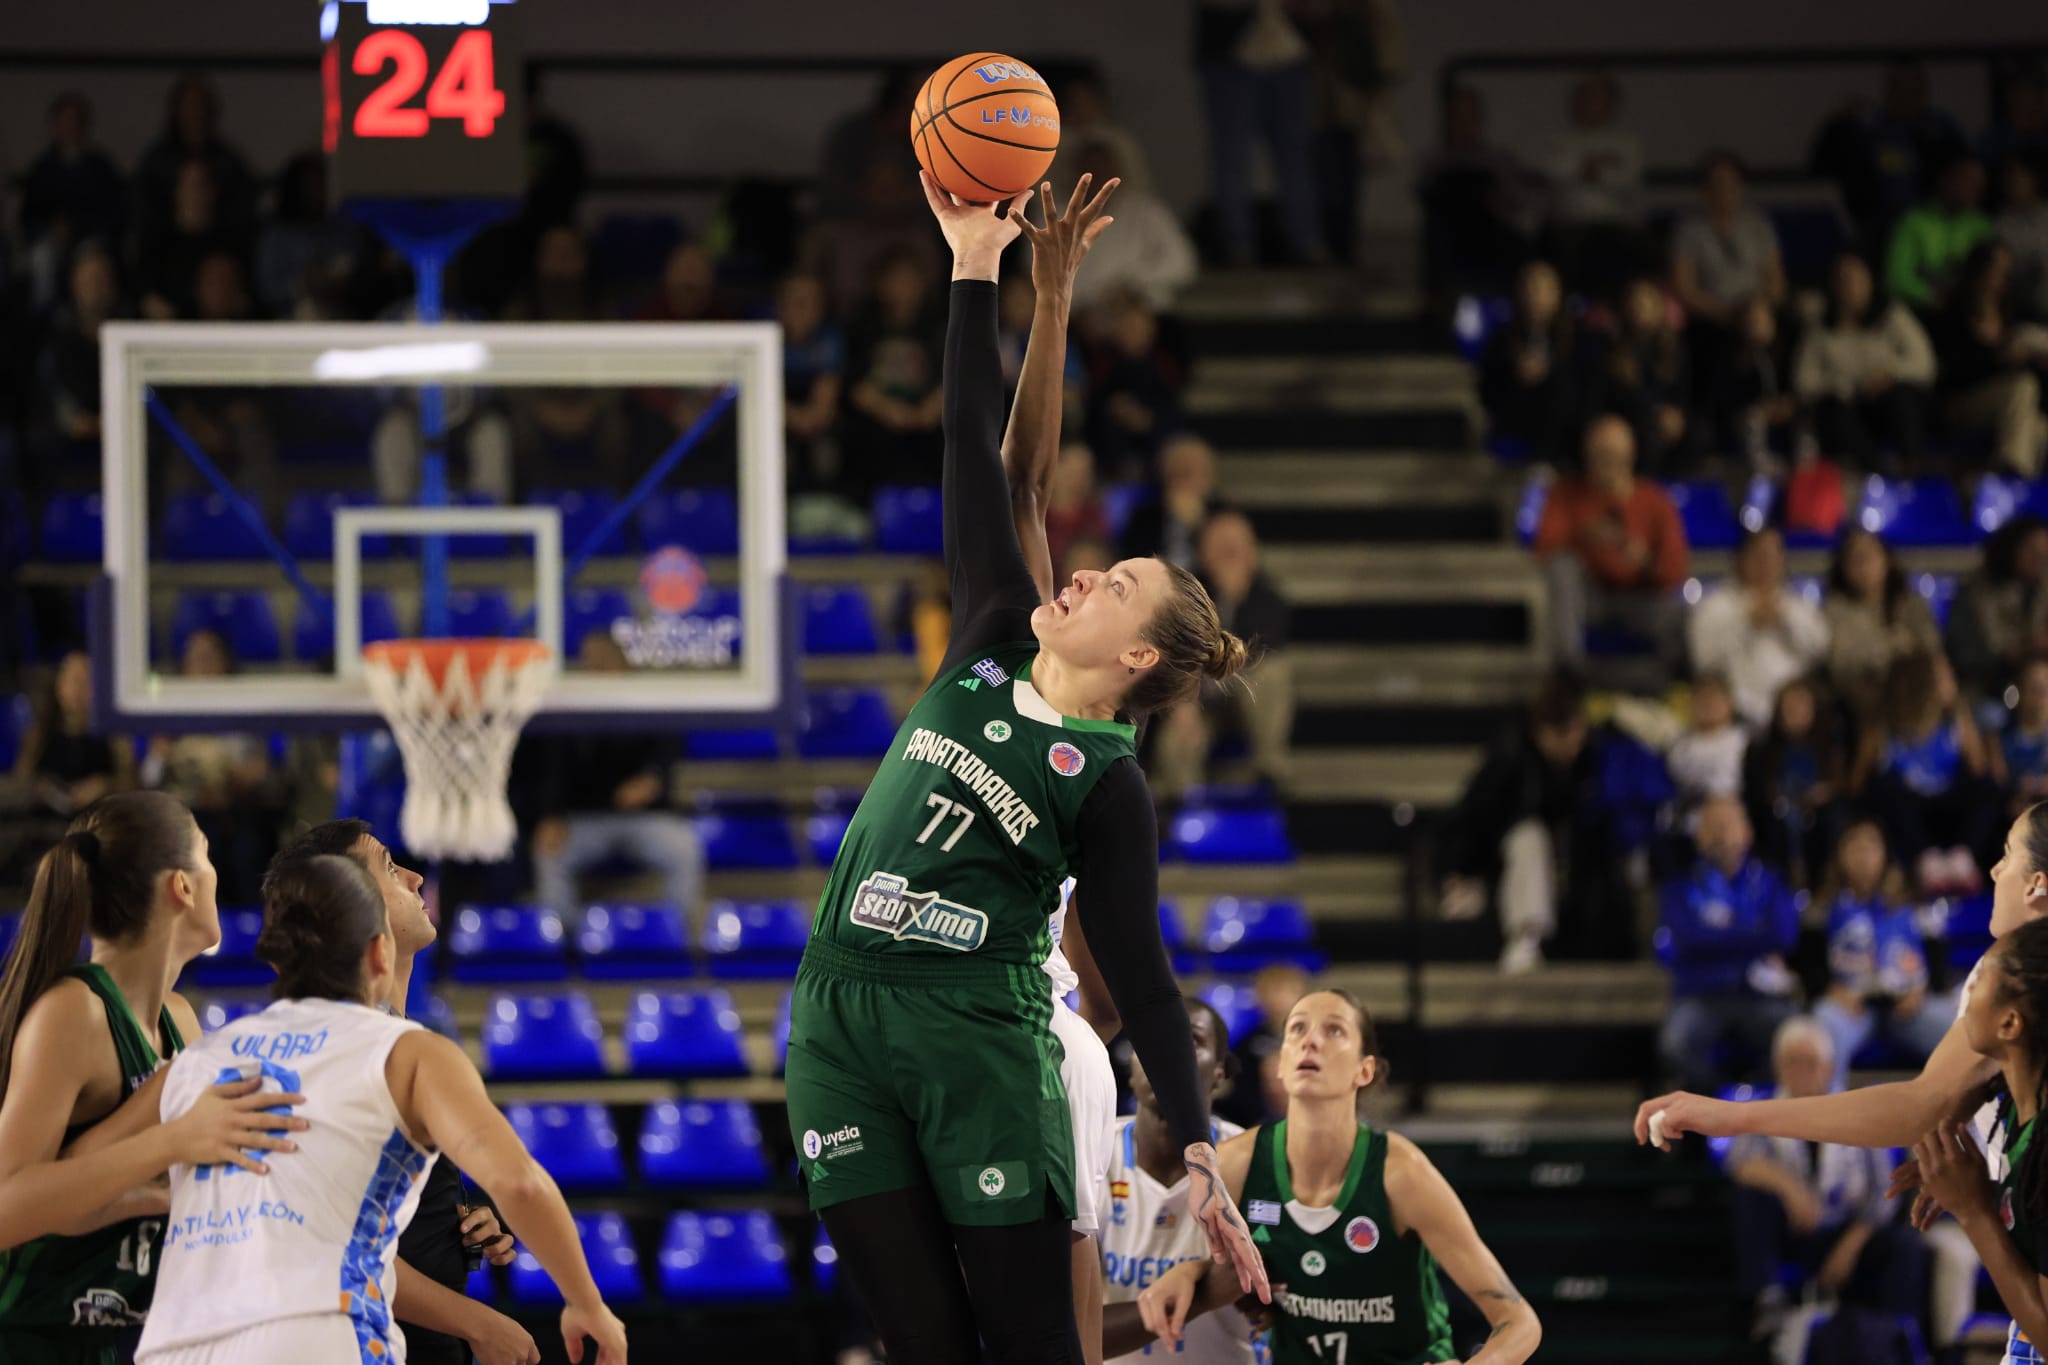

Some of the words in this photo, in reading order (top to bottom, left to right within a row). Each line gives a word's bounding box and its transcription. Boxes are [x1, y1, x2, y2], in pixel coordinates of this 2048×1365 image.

[352, 29, 505, 138] 24
[982, 109, 1007, 123] LF
[902, 727, 1040, 846] PANATHINAIKOS
[915, 791, 976, 853] 77
